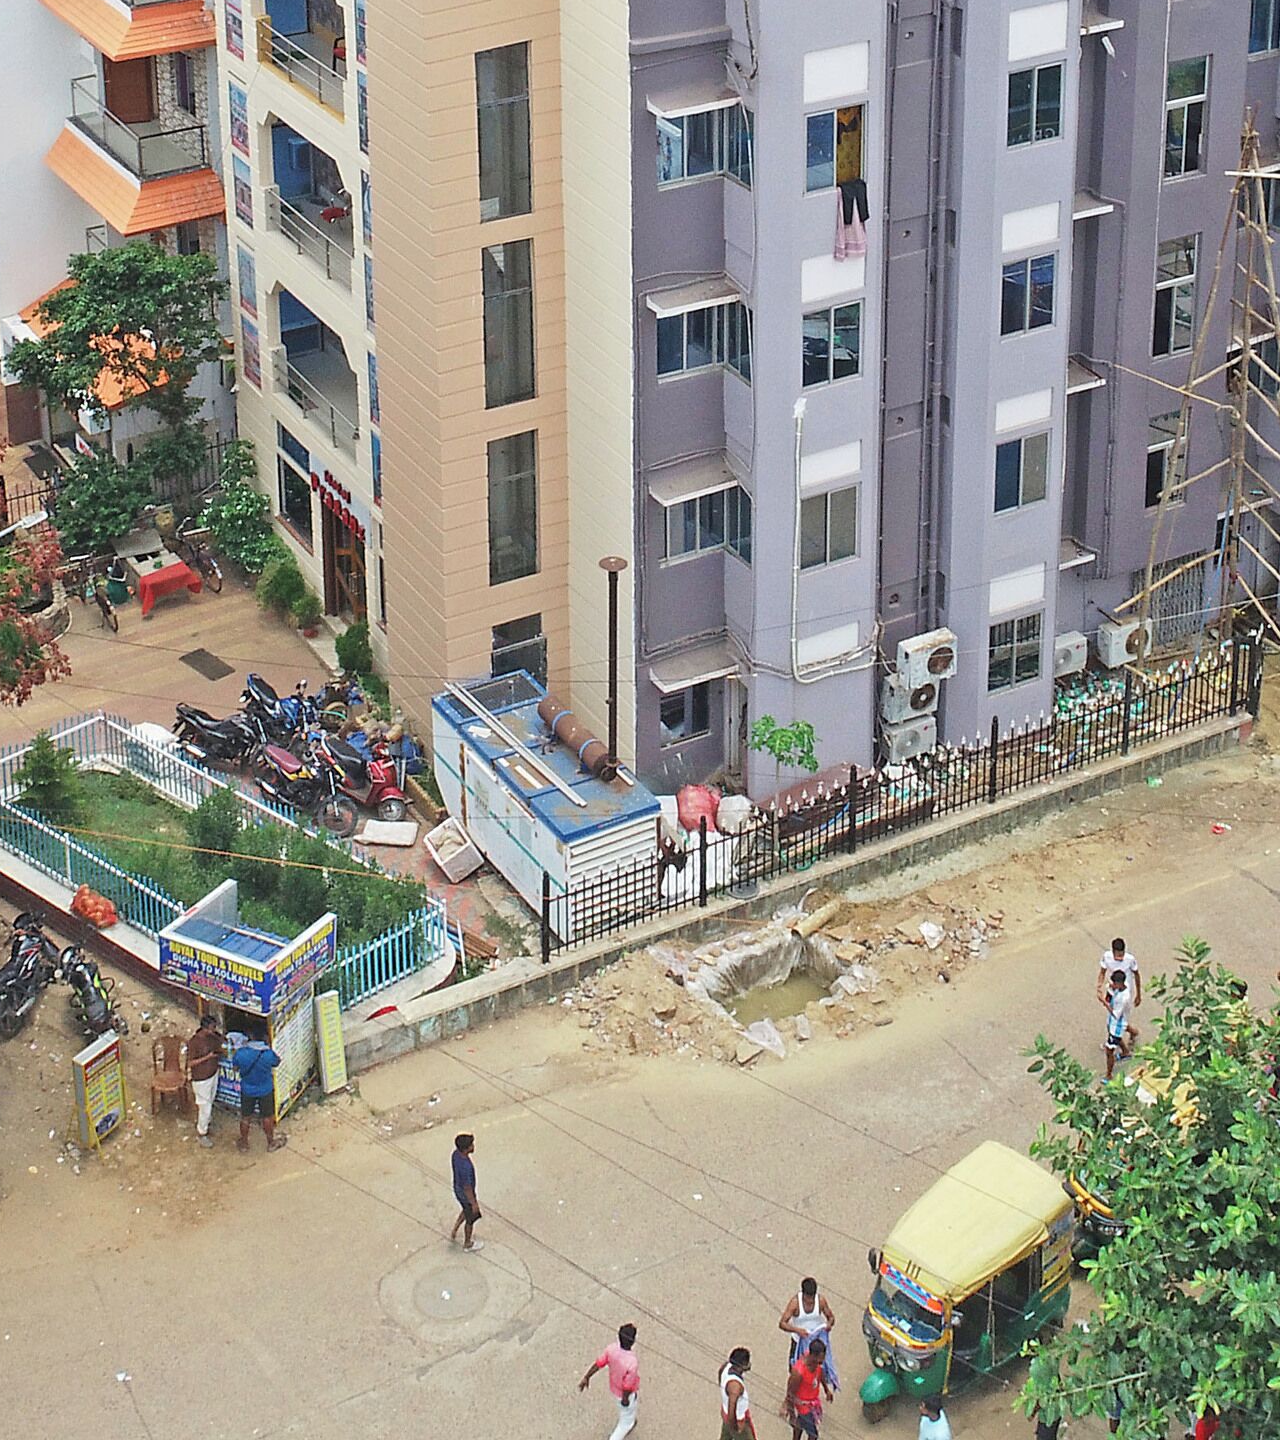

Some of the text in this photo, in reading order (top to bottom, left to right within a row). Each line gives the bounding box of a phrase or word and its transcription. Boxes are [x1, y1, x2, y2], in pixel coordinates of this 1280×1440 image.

[170, 941, 264, 982] ROYAL TOUR & TRAVELS
[172, 953, 254, 988] DIGHA TO KOLKATA
